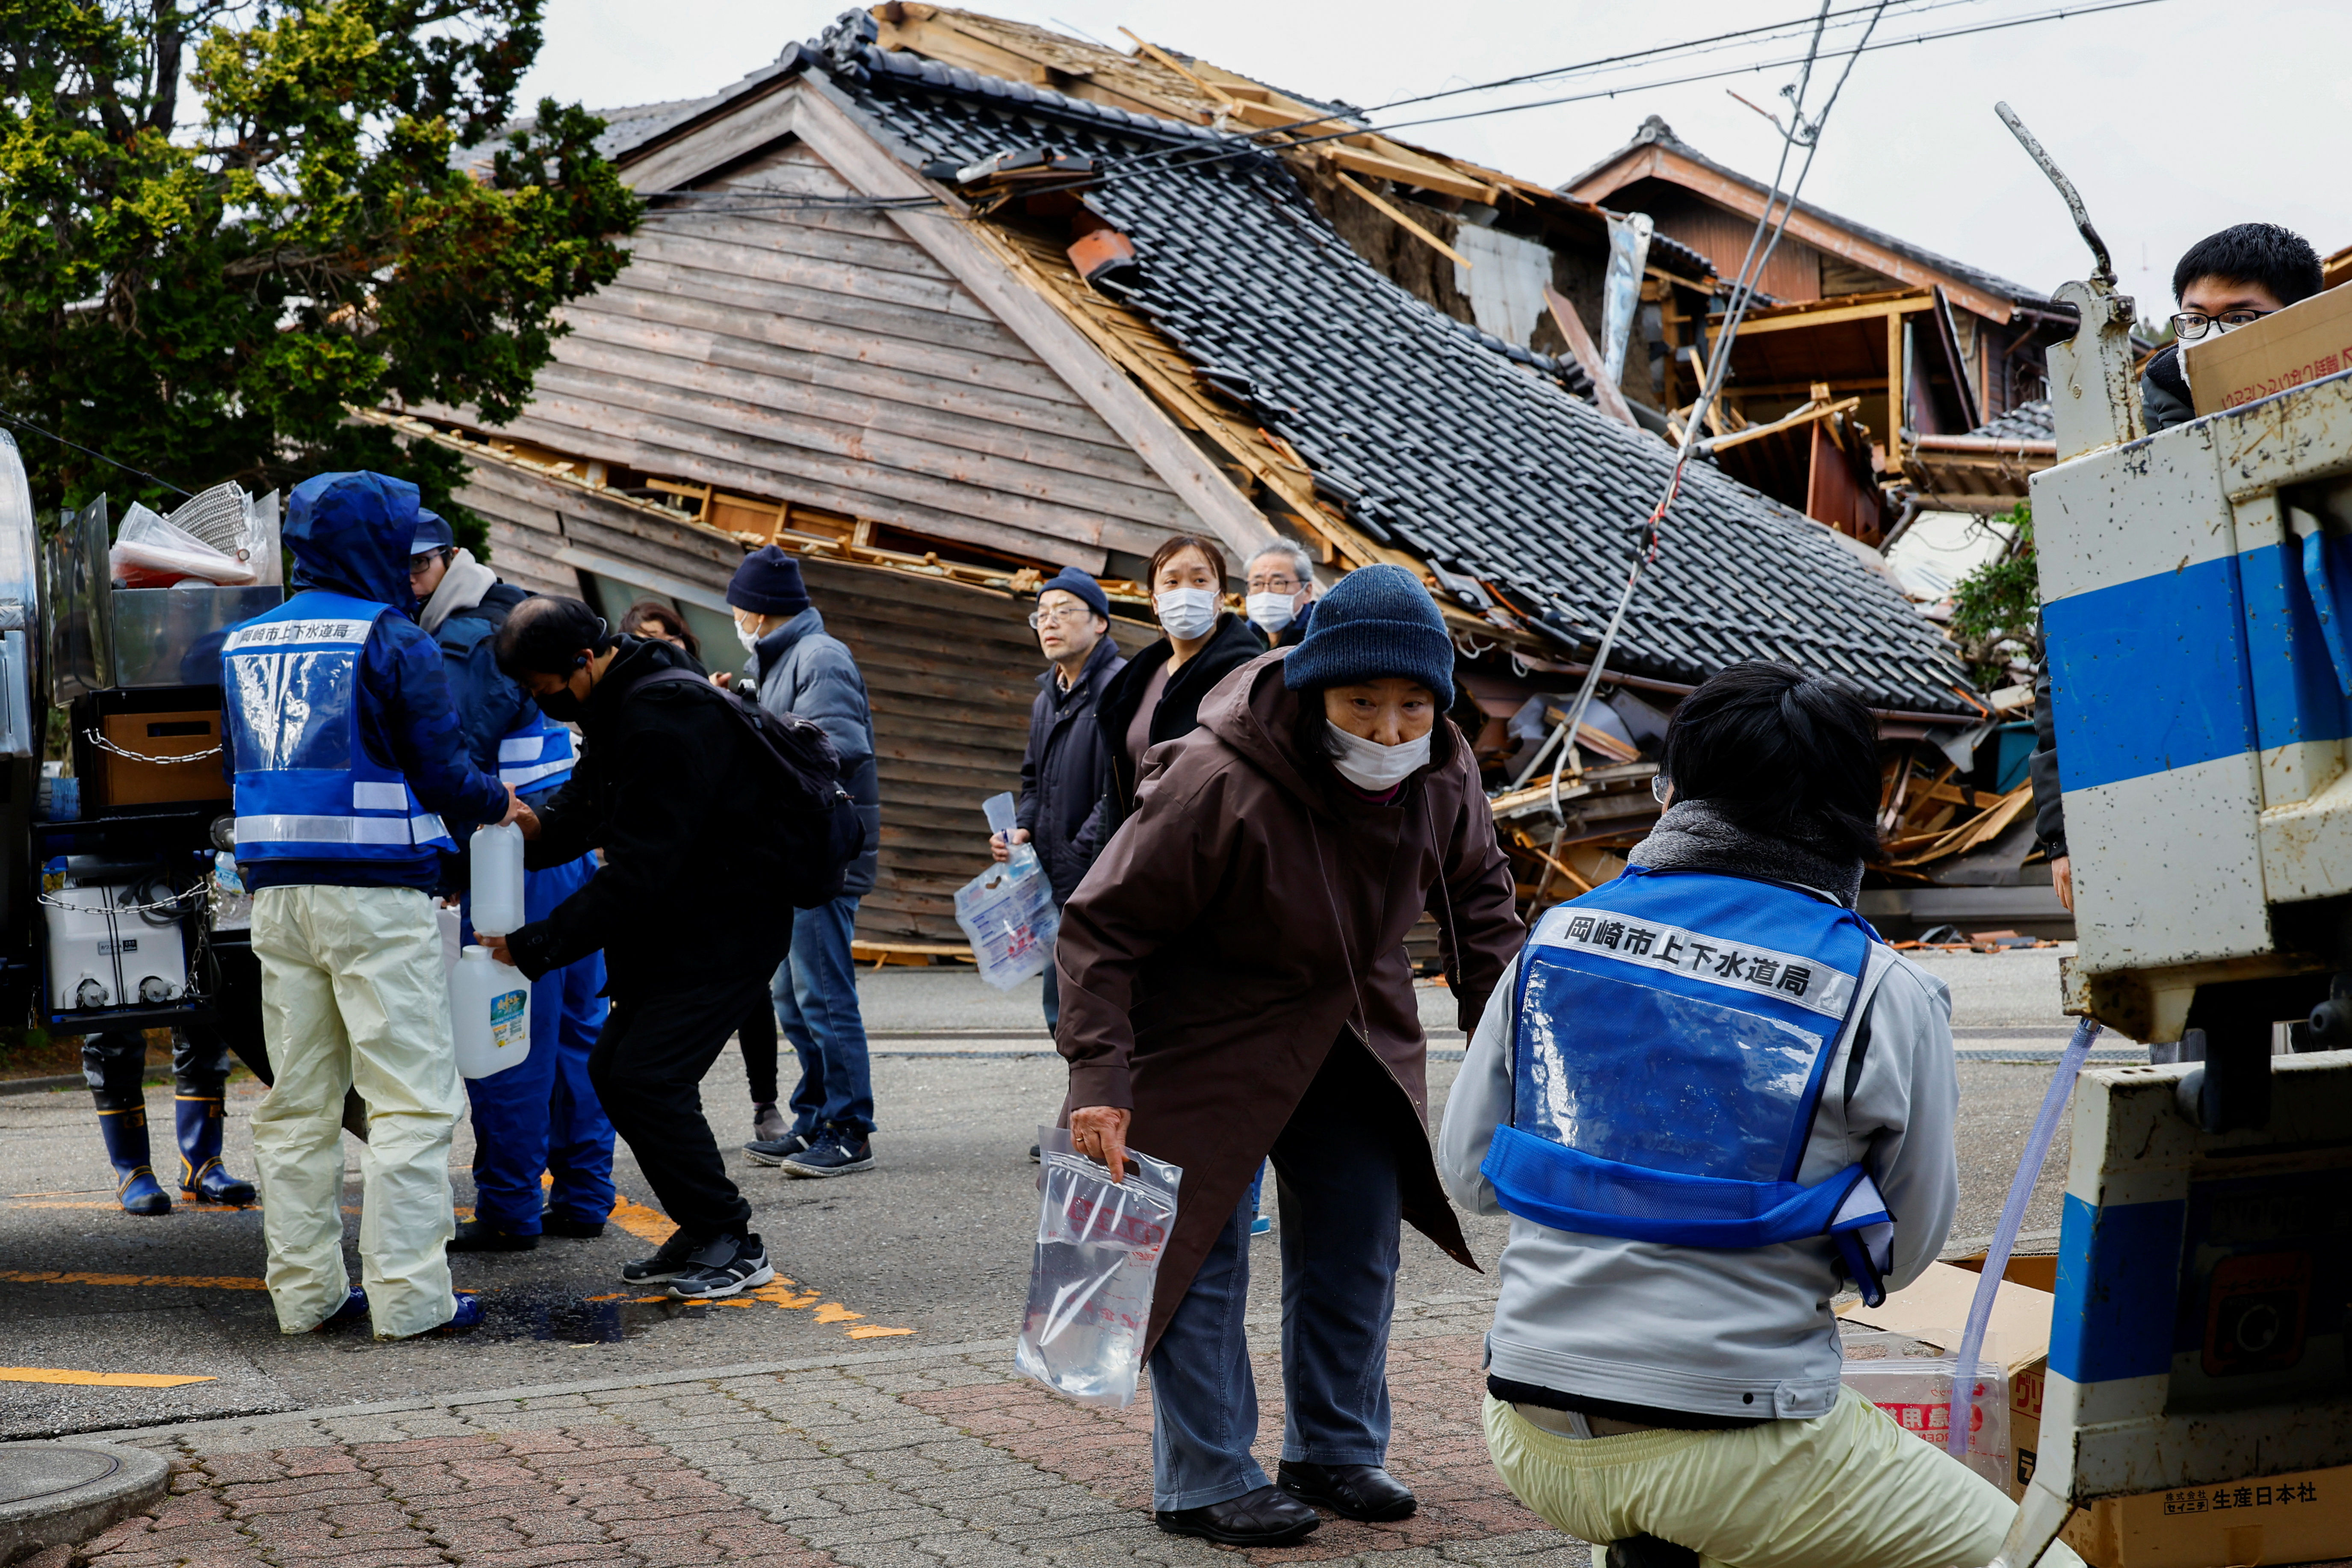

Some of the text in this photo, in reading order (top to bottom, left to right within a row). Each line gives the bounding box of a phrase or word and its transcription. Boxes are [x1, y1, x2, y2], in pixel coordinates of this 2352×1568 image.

[240, 624, 349, 642] 岡崎市上下水道局
[1564, 915, 1812, 996] 岡崎市上下水道局
[2165, 1490, 2207, 1502] 株式会社
[2213, 1482, 2317, 1510] 生産日本社
[2167, 1501, 2206, 1512] セイニチ
